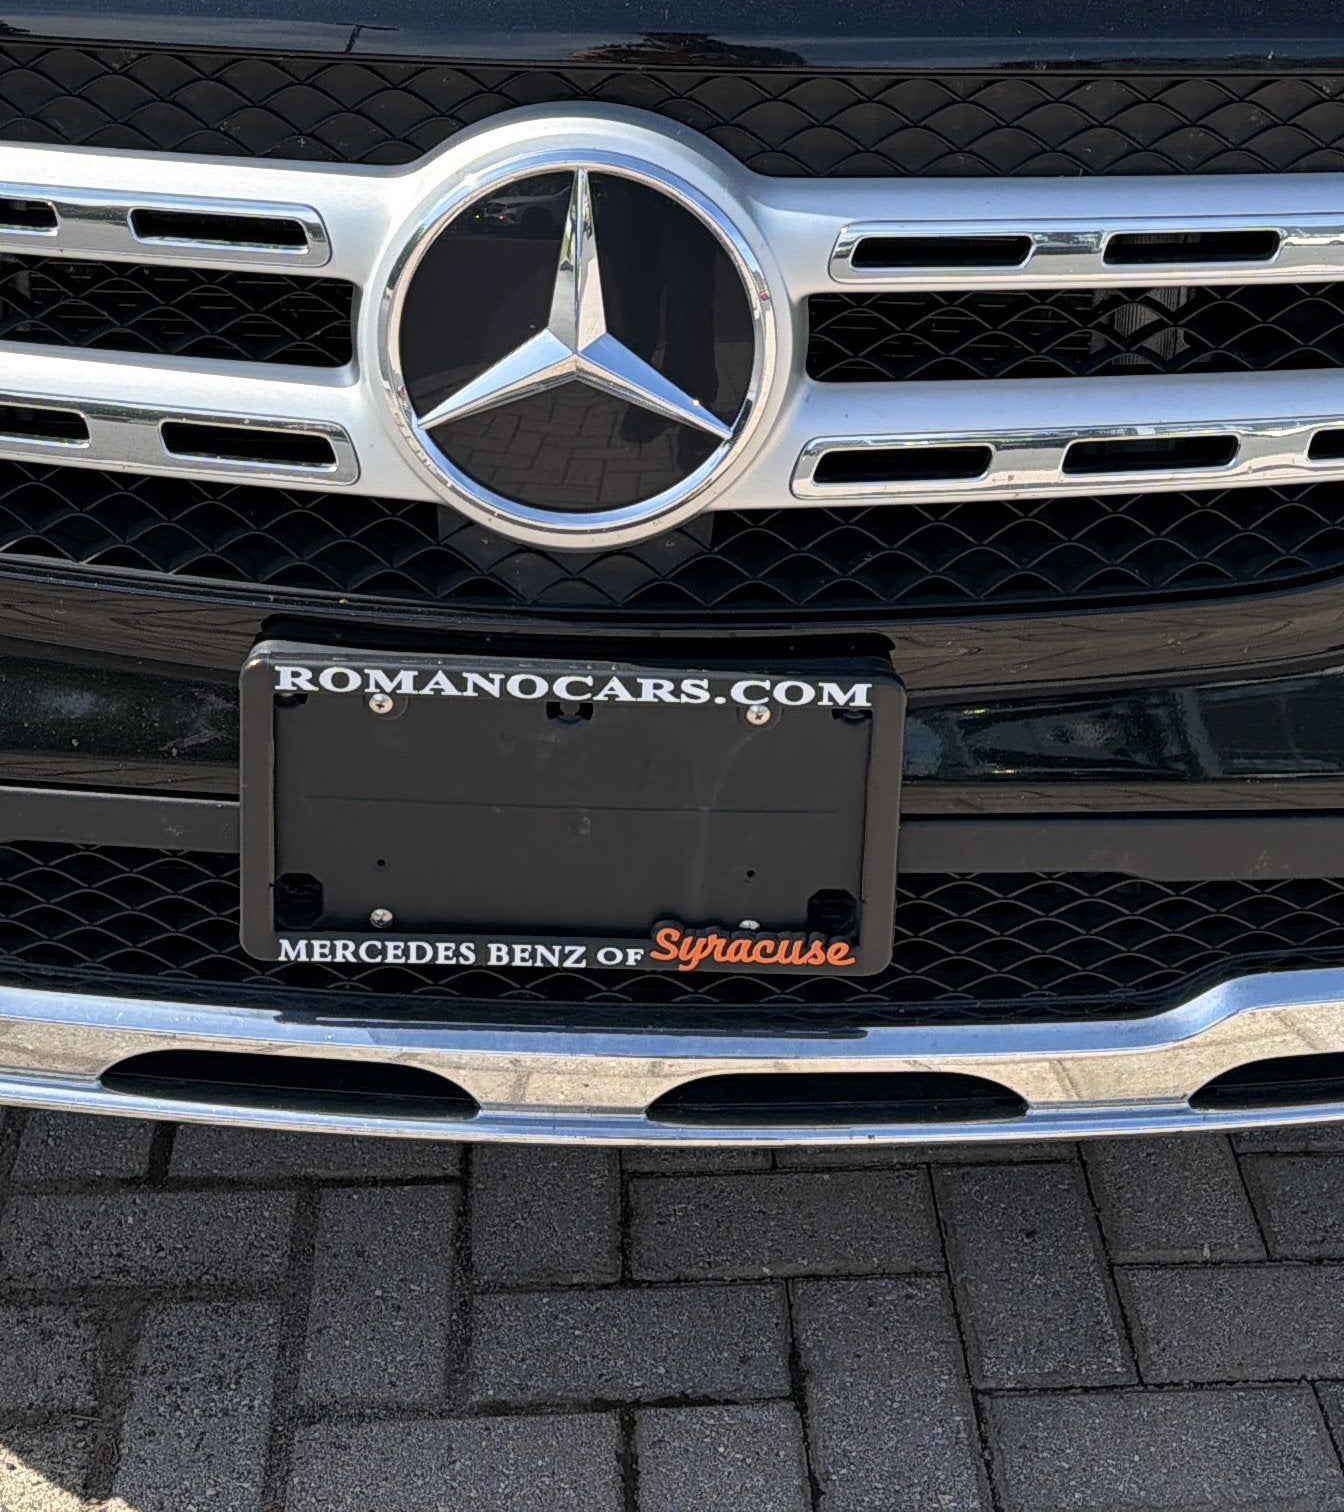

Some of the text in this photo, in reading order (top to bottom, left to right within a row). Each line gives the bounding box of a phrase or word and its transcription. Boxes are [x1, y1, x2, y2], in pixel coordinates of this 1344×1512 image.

[274, 665, 872, 707] ROMANOCARS.COM
[277, 927, 856, 972] MERCEDES BENZ OF Syracuse
